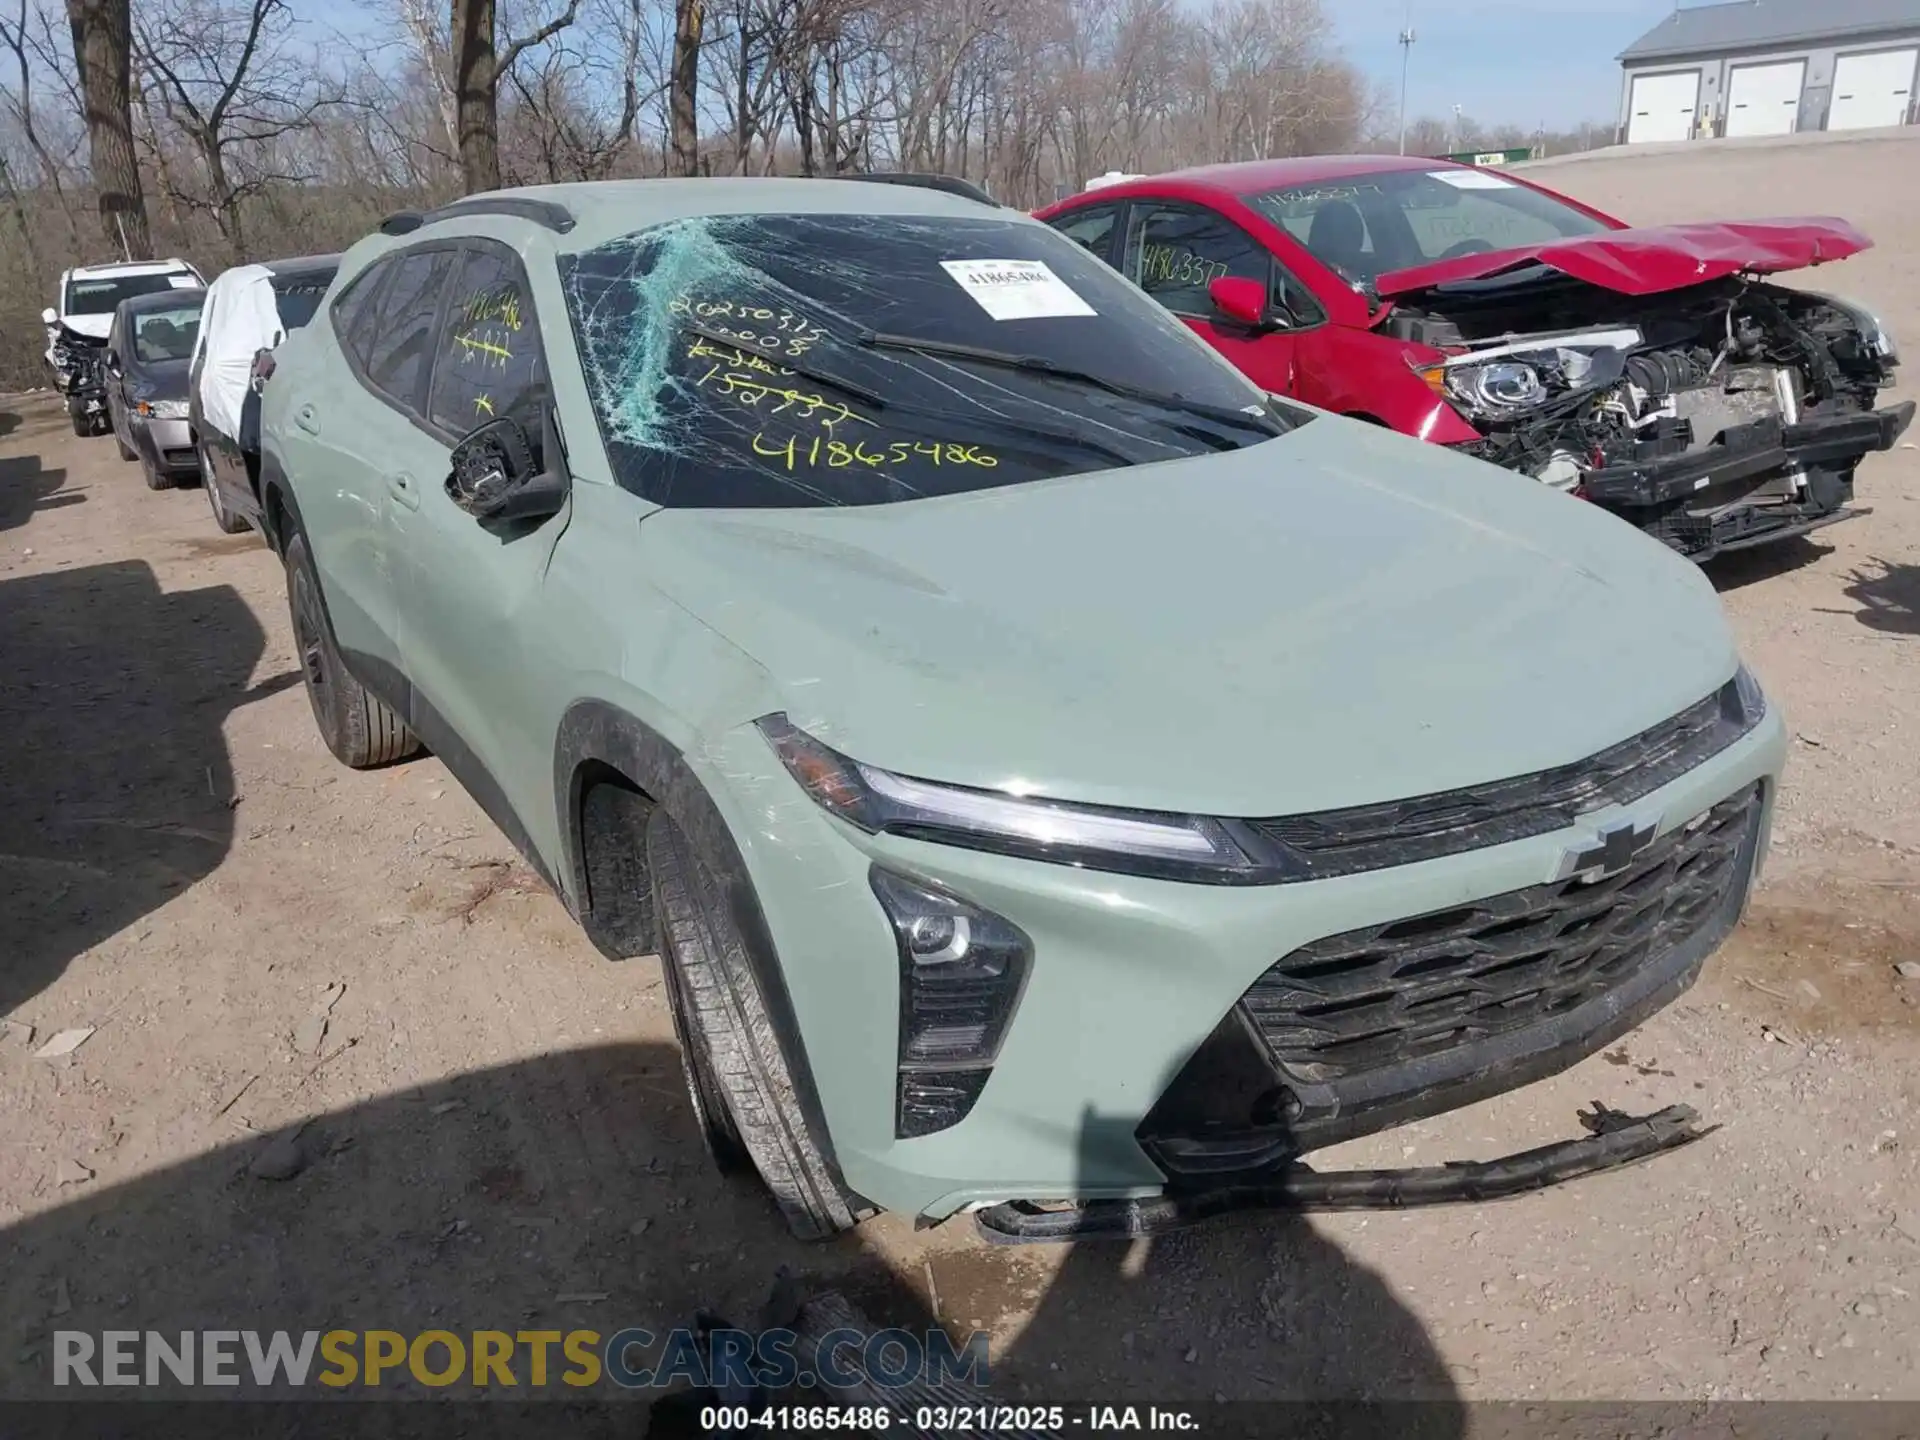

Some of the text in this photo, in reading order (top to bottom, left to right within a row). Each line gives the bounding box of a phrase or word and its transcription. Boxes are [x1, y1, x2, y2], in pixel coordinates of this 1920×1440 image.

[967, 271, 1051, 285] 41865486
[1142, 244, 1228, 289] 41863377
[753, 432, 998, 470] 41865486
